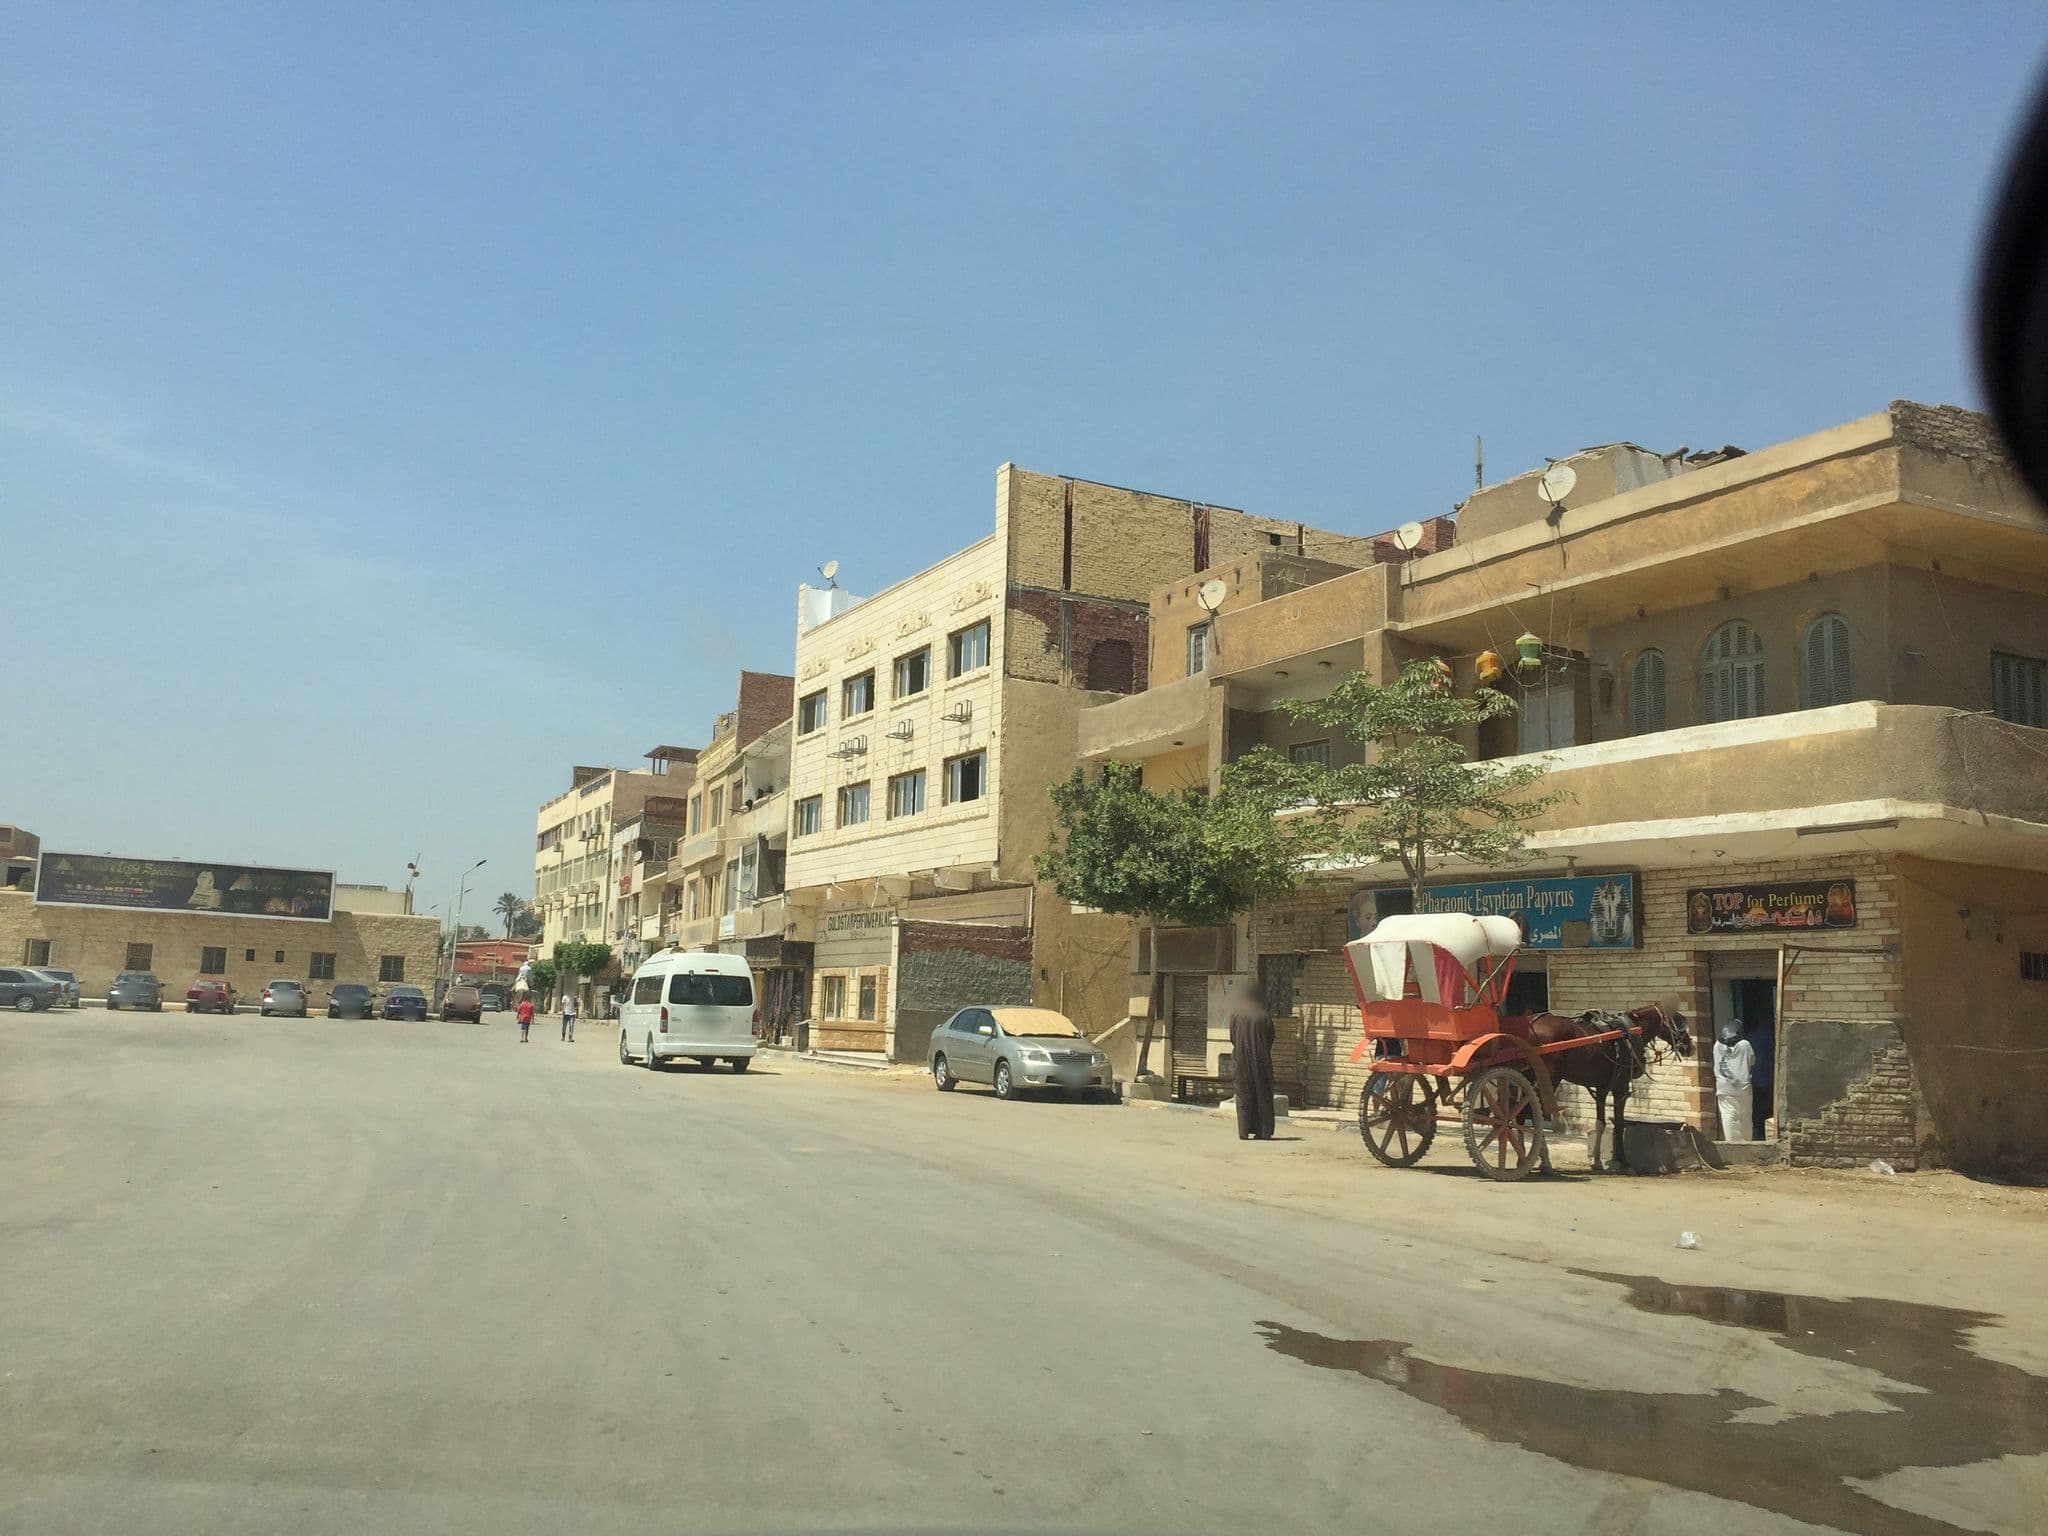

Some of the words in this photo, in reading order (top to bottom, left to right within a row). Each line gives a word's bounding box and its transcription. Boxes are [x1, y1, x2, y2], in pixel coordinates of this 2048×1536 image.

[1422, 890, 1473, 913] Pharaonic
[1475, 886, 1524, 916] Egyptian
[1526, 885, 1575, 916] Papyrus
[1712, 892, 1744, 911] TOP
[1747, 894, 1765, 909] for
[1768, 891, 1825, 908] Perfume
